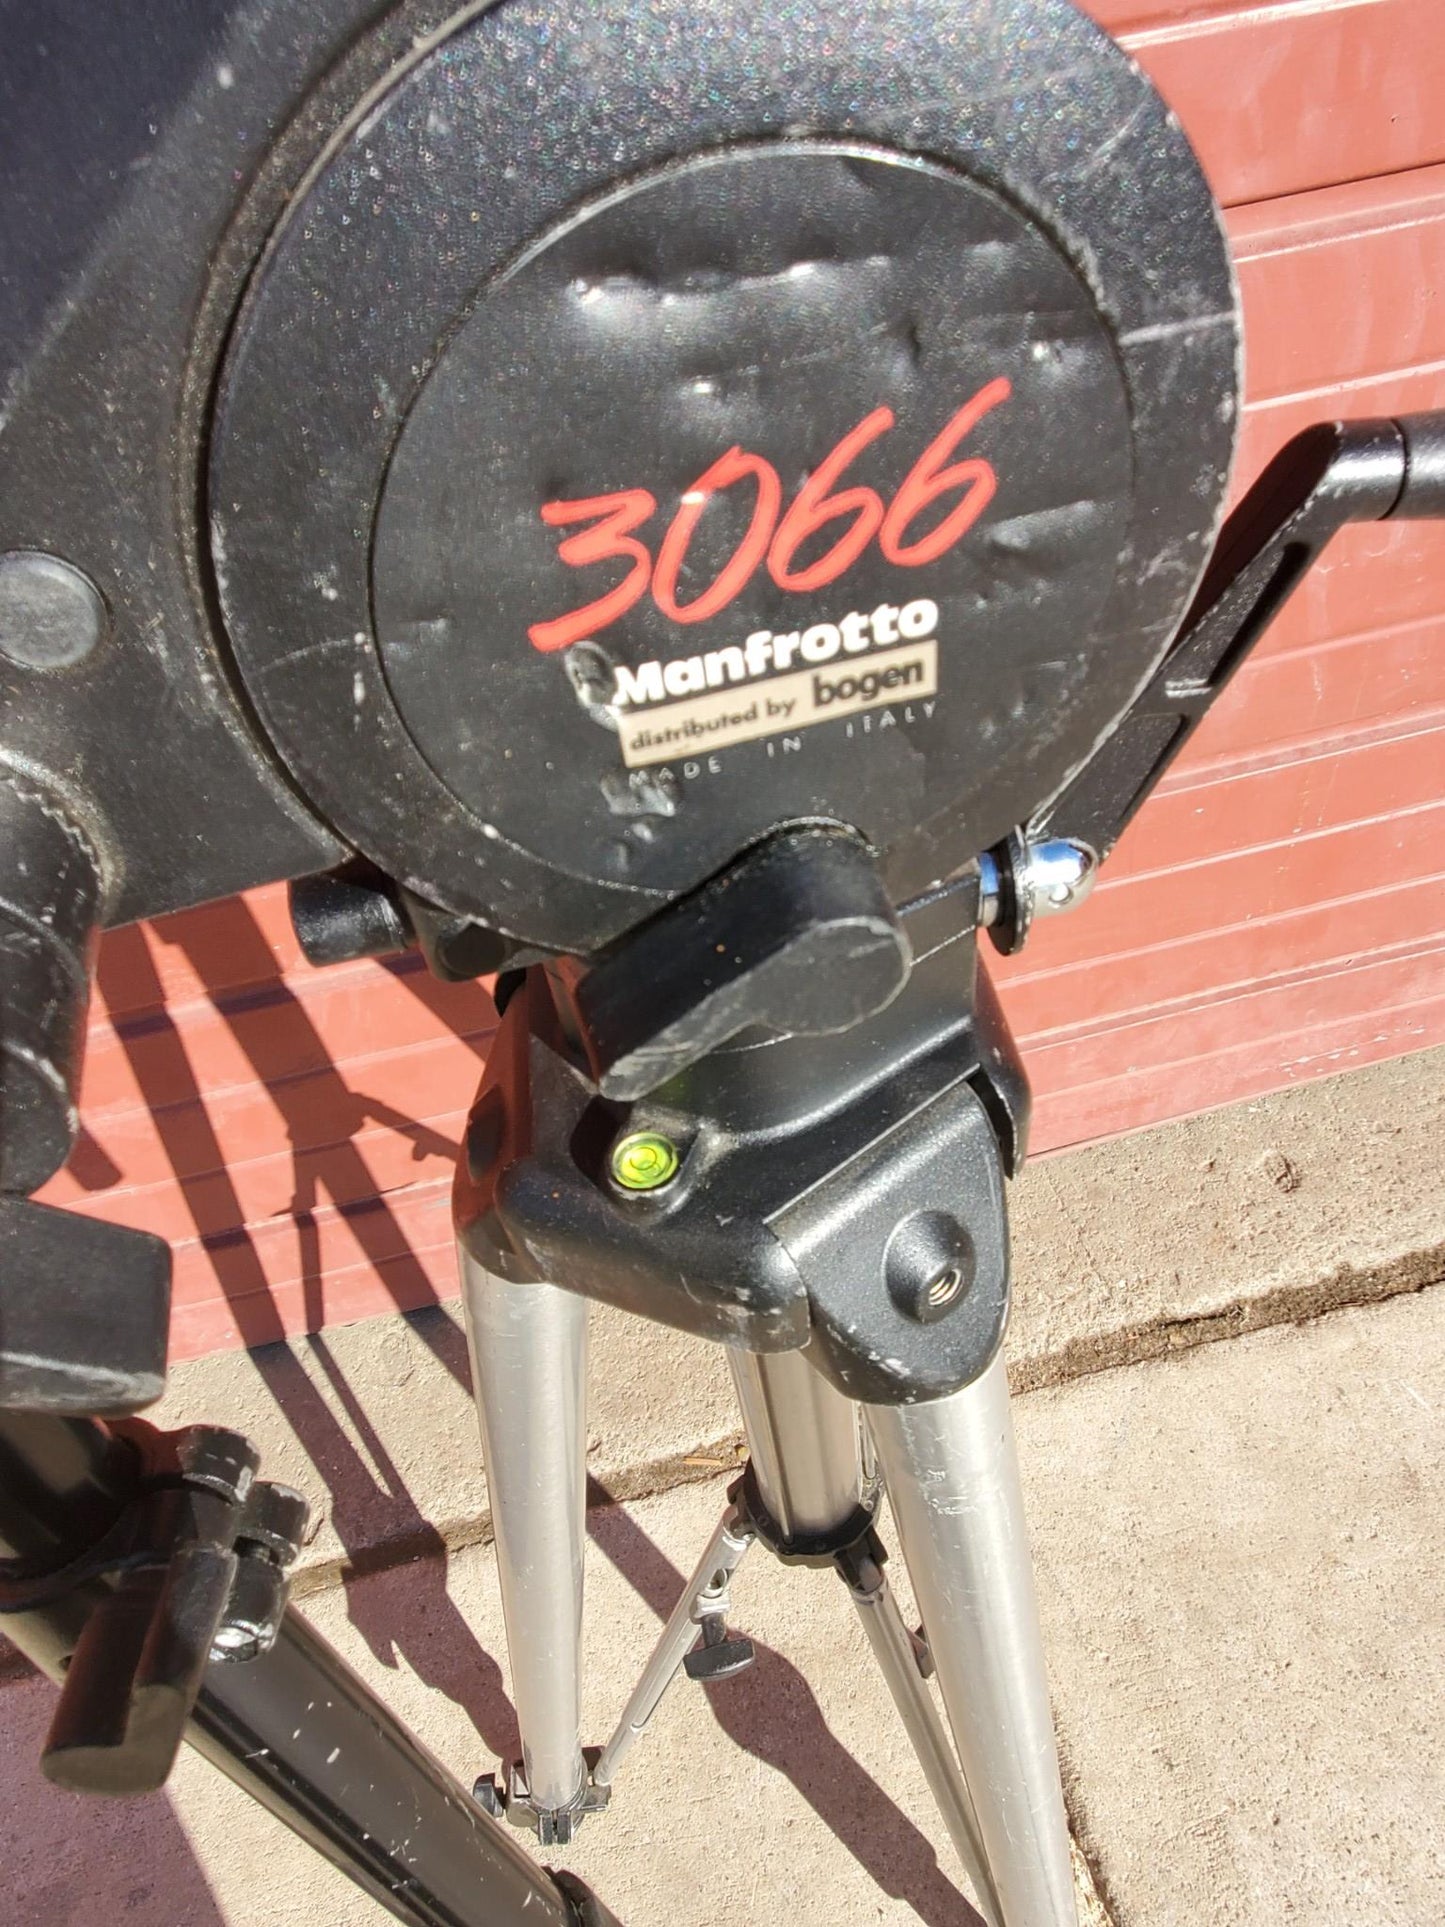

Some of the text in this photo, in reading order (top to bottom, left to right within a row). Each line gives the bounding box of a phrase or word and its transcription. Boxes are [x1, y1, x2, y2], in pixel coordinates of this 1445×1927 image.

[527, 376, 1012, 653] 3066
[612, 599, 939, 706] Manfrotto
[629, 659, 925, 752] distributed by bogen
[629, 700, 937, 786] MADE IN ITALY
